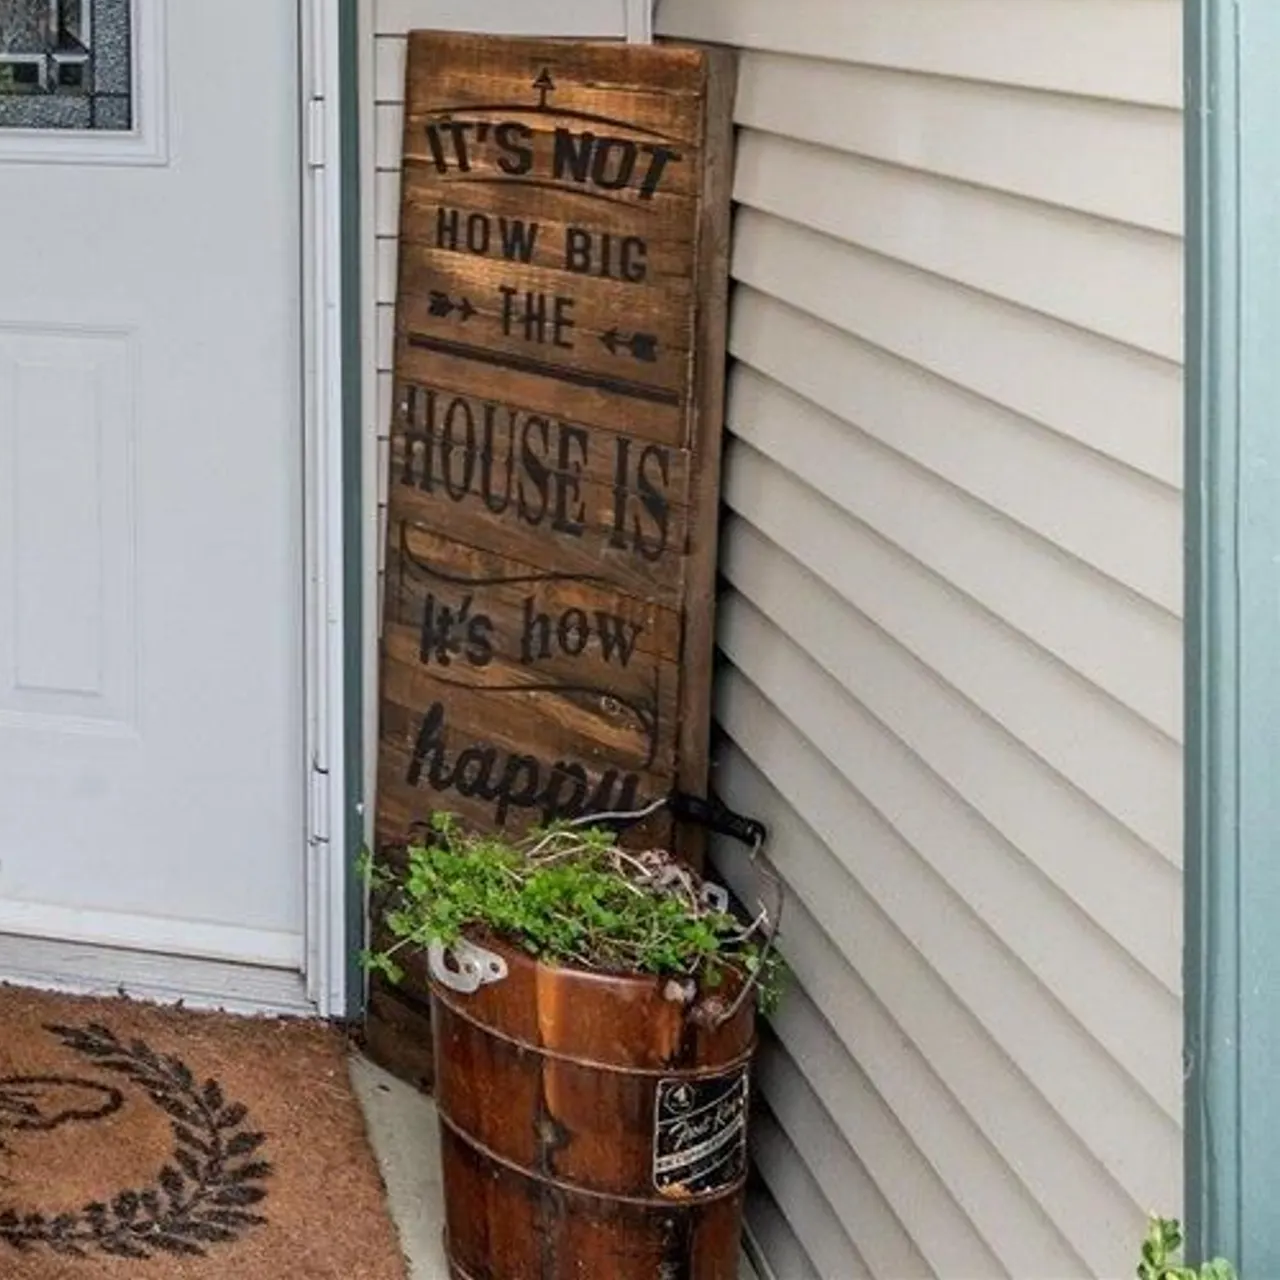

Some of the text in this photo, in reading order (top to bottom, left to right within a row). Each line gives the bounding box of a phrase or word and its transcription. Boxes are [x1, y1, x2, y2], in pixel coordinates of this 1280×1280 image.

[425, 116, 682, 201] IT'S NOT
[435, 207, 648, 282] HOW BIG
[498, 285, 575, 350] THE
[399, 384, 671, 563] HOUSE IS
[419, 592, 644, 669] It's how
